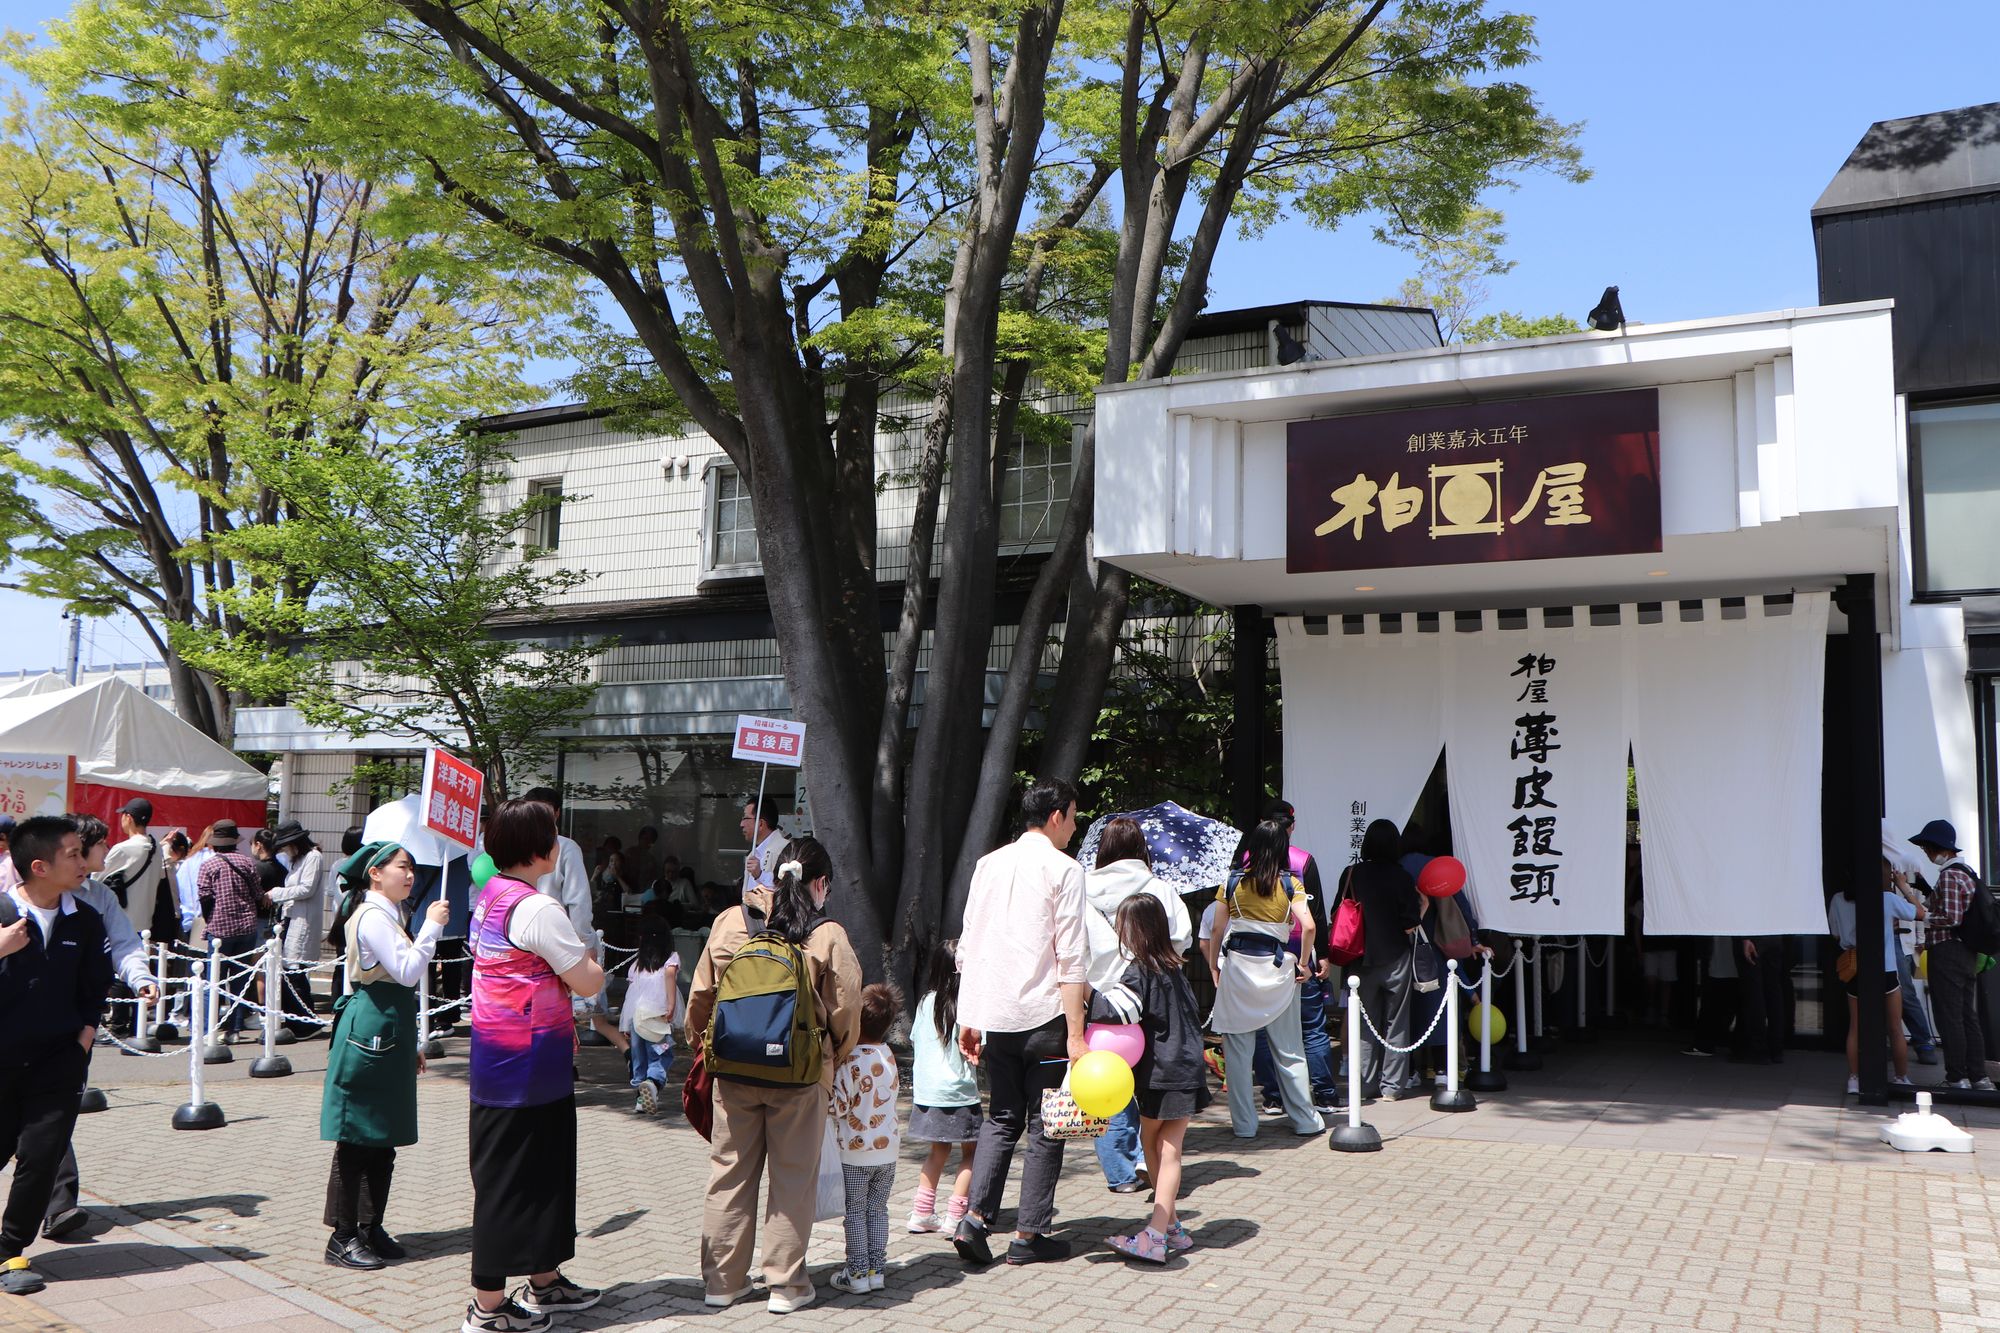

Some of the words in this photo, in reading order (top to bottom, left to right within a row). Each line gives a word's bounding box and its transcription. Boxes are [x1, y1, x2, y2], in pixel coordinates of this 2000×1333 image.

[1406, 425, 1529, 453] 創業嘉永五年
[744, 732, 794, 751] 最後尾
[0, 760, 63, 770] ャレンジしよう!
[437, 761, 477, 799] 洋菓子列
[430, 790, 476, 840] 最後尾
[1066, 1118, 1085, 1127] cher
